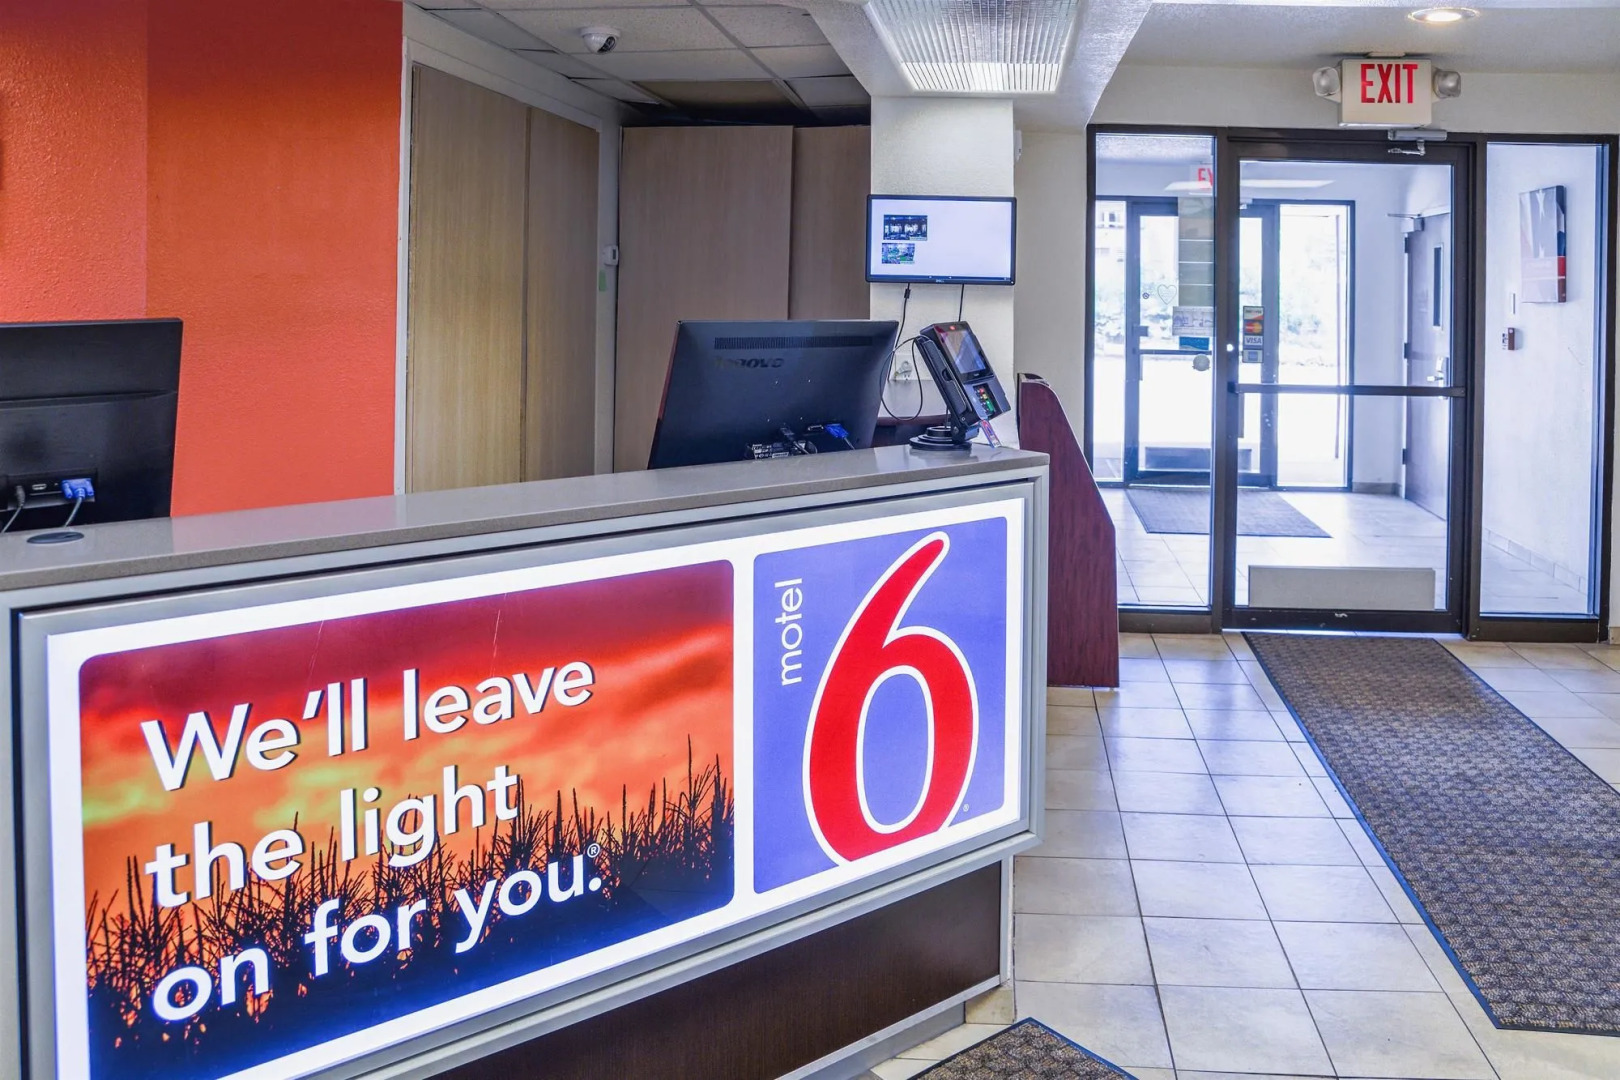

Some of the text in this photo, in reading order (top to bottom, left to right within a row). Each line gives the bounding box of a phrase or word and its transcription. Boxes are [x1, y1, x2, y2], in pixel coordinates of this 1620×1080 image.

[1360, 63, 1418, 104] EXIT
[1245, 336, 1263, 344] VISA
[774, 577, 803, 686] motel
[141, 661, 595, 792] We'll leave
[803, 531, 979, 866] 6
[145, 764, 520, 908] the light
[153, 948, 269, 1022] on
[304, 898, 427, 977] for
